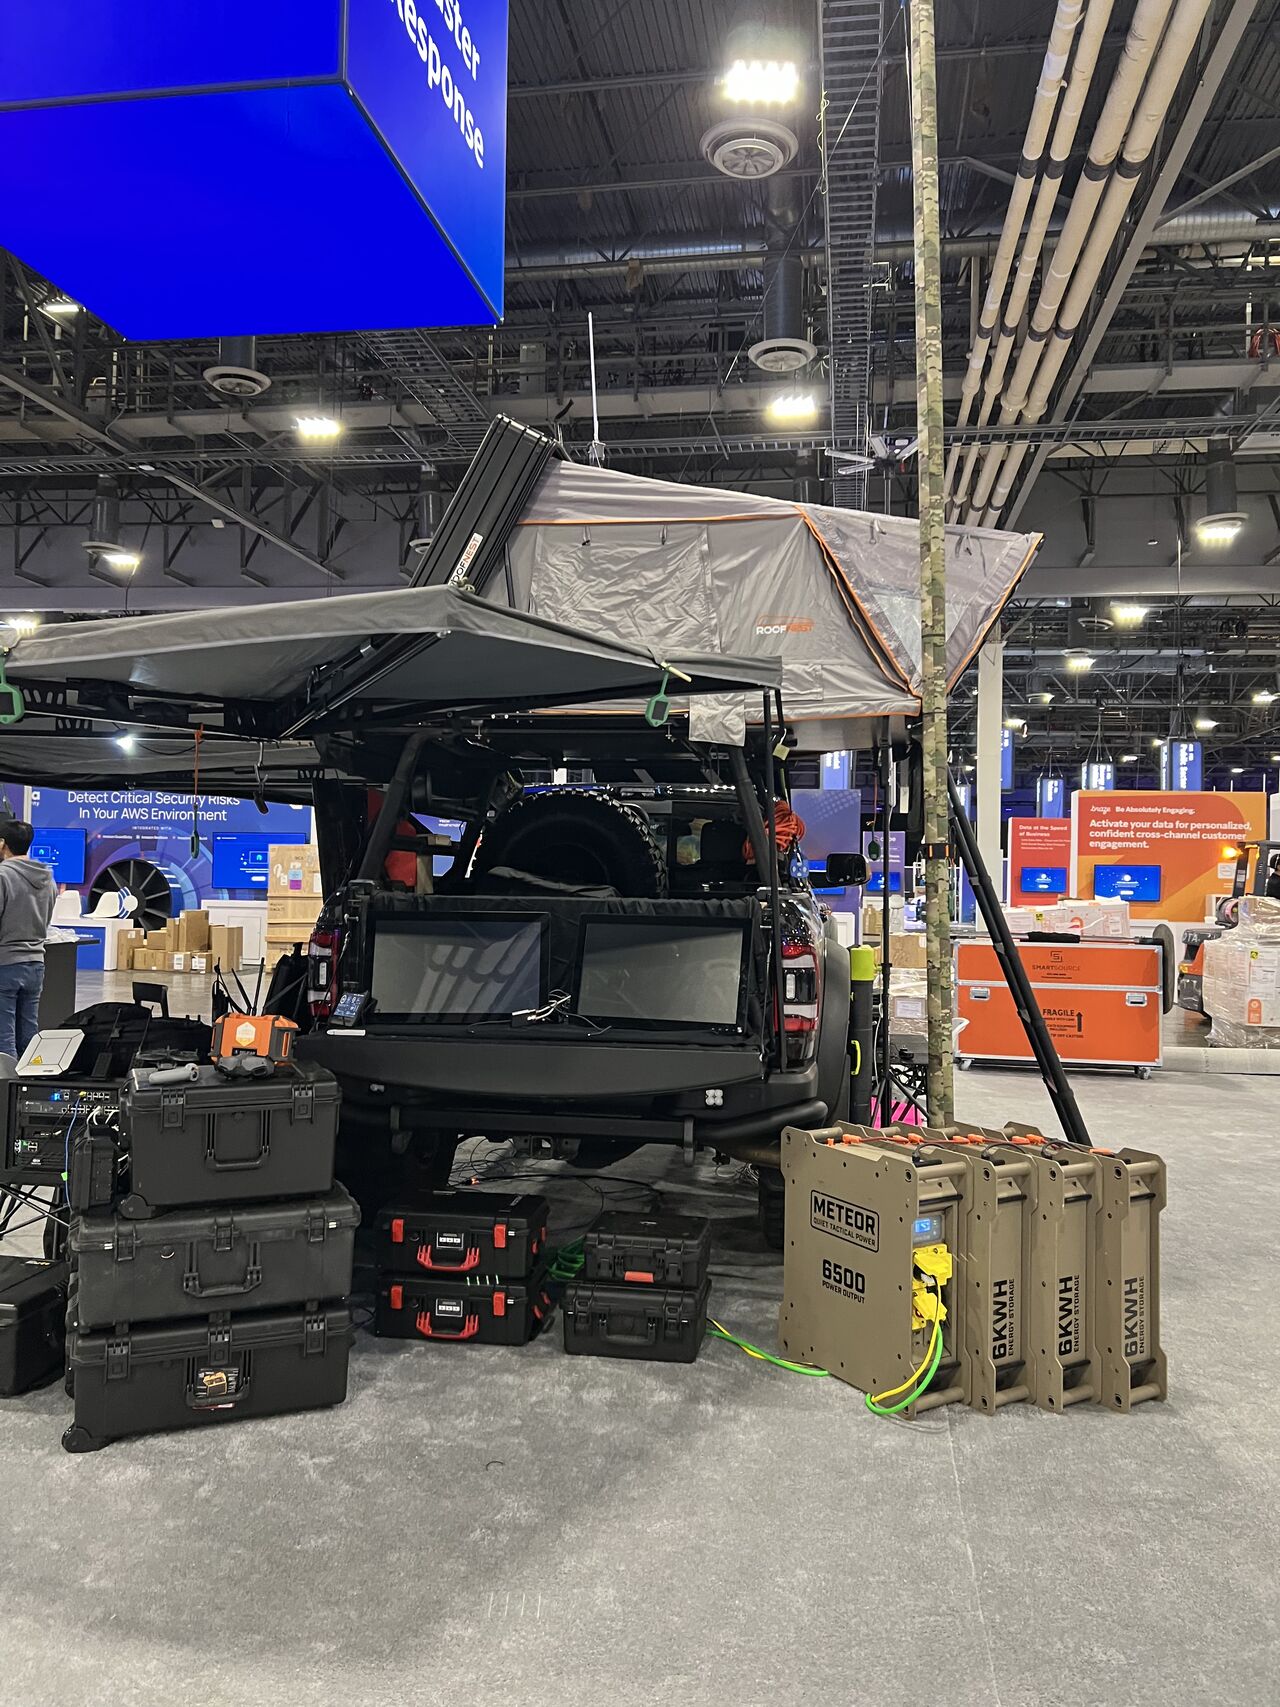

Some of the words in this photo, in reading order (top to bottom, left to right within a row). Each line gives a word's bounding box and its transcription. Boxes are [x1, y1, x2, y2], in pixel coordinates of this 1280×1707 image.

[434, 0, 480, 81] ster
[68, 791, 108, 804] Detect
[110, 792, 152, 804] Critical
[79, 807, 90, 819] In
[92, 808, 118, 819] Your
[121, 808, 149, 820] AWS
[151, 808, 228, 821] Environment
[1089, 819, 1130, 828] Activate
[1130, 821, 1151, 830] your
[1152, 820, 1174, 829] data
[1175, 820, 1190, 829] for
[1190, 821, 1252, 831] personalized,
[1089, 830, 1134, 838] confident
[1136, 831, 1200, 840] cross-channel
[1089, 841, 1150, 850] engagement.
[1042, 1008, 1075, 1016] FRAGILE
[814, 1195, 876, 1236] METEOR
[814, 1217, 828, 1229] QUIET
[830, 1222, 854, 1238] TACTICAL
[856, 1233, 876, 1247] POWER
[823, 1259, 865, 1294] 6500
[822, 1280, 841, 1295] POWER
[843, 1289, 865, 1303] OUTPUT
[992, 1279, 1008, 1360] 6KWH
[1058, 1276, 1073, 1356] 6KWH
[1124, 1277, 1138, 1357] 6KWH
